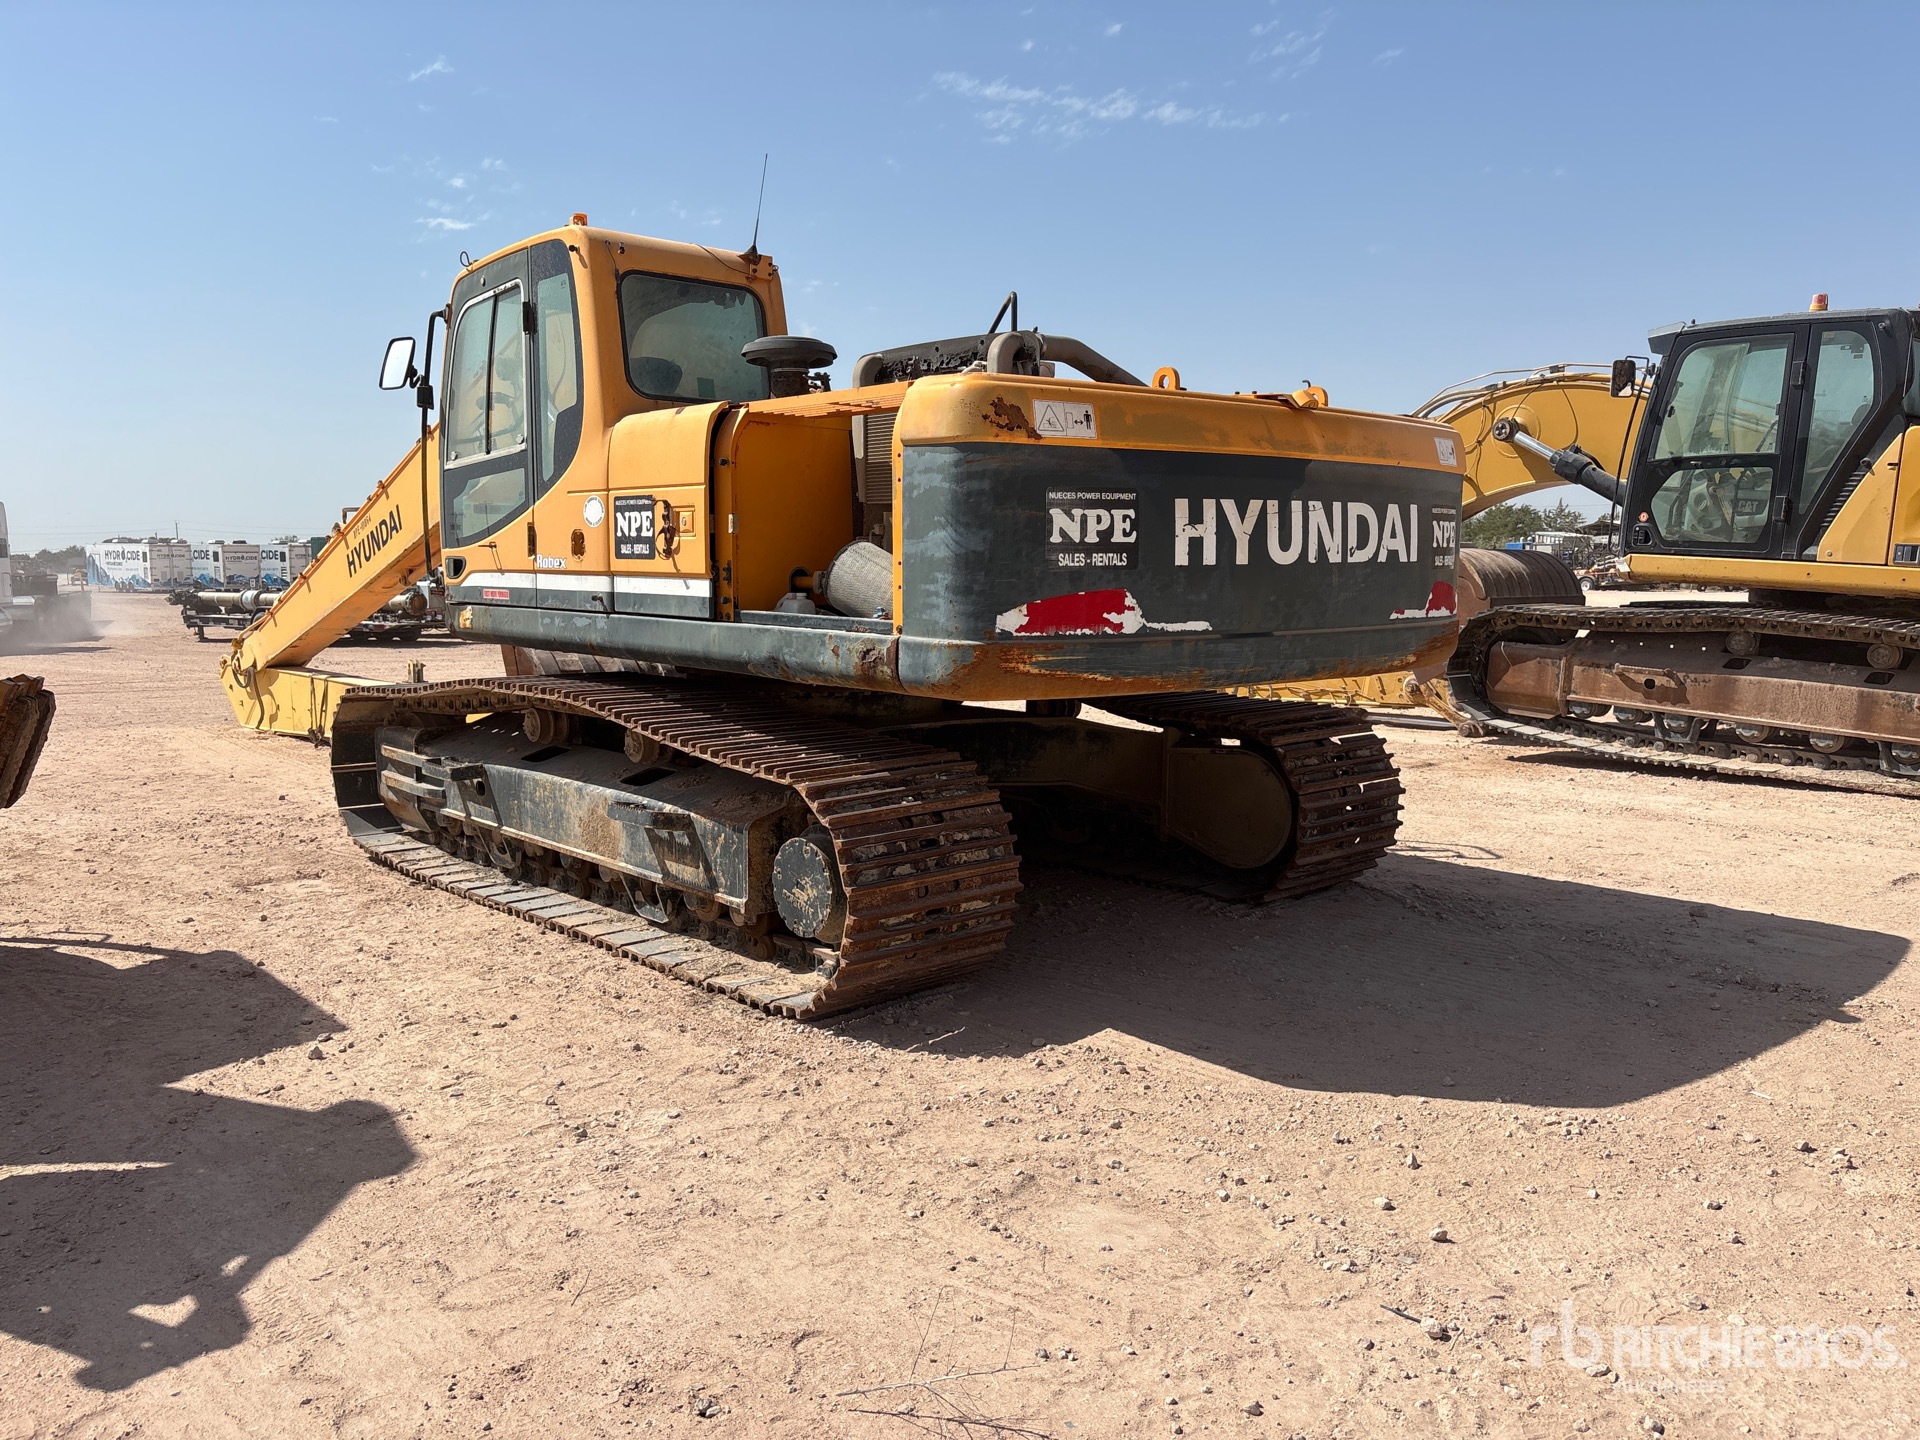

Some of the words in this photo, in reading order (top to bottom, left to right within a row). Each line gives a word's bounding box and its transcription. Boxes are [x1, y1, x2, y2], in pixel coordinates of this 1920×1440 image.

[1049, 492, 1076, 500] NUECES
[1738, 500, 1759, 513] CAT
[616, 511, 653, 537] NPE
[1049, 508, 1137, 543] NPE
[1174, 498, 1418, 566] HYUNDAI
[1432, 520, 1456, 548] NPE
[346, 504, 402, 578] HYUNDAI
[620, 544, 632, 555] SALES
[536, 553, 568, 569] Robex
[1058, 553, 1085, 566] SALES
[1092, 553, 1127, 566] RENTALS
